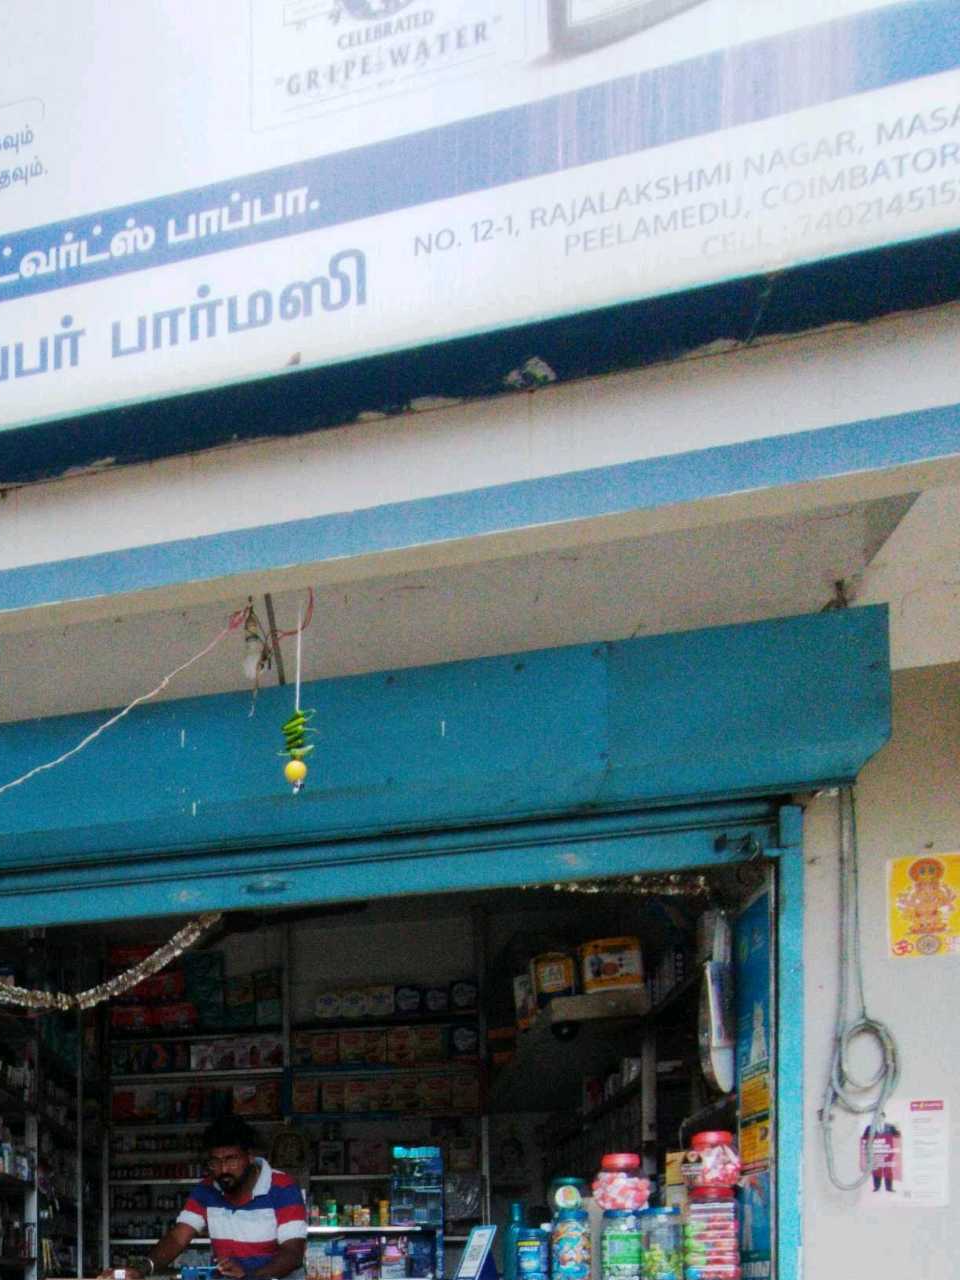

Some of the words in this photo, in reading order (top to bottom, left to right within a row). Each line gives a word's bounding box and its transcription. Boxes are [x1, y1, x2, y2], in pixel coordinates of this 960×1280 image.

[337, 10, 435, 50] CELEBRATED
[166, 186, 320, 245] பாப்பா.
[413, 228, 462, 257] NO.
[471, 214, 520, 243] 12-1,
[529, 159, 733, 230] RAJALAKSHMI
[743, 129, 864, 179] NAGAR,
[798, 177, 960, 239] 740214515
[563, 198, 752, 257] PEELAMEDU,
[110, 247, 368, 359] பார்மஸி
